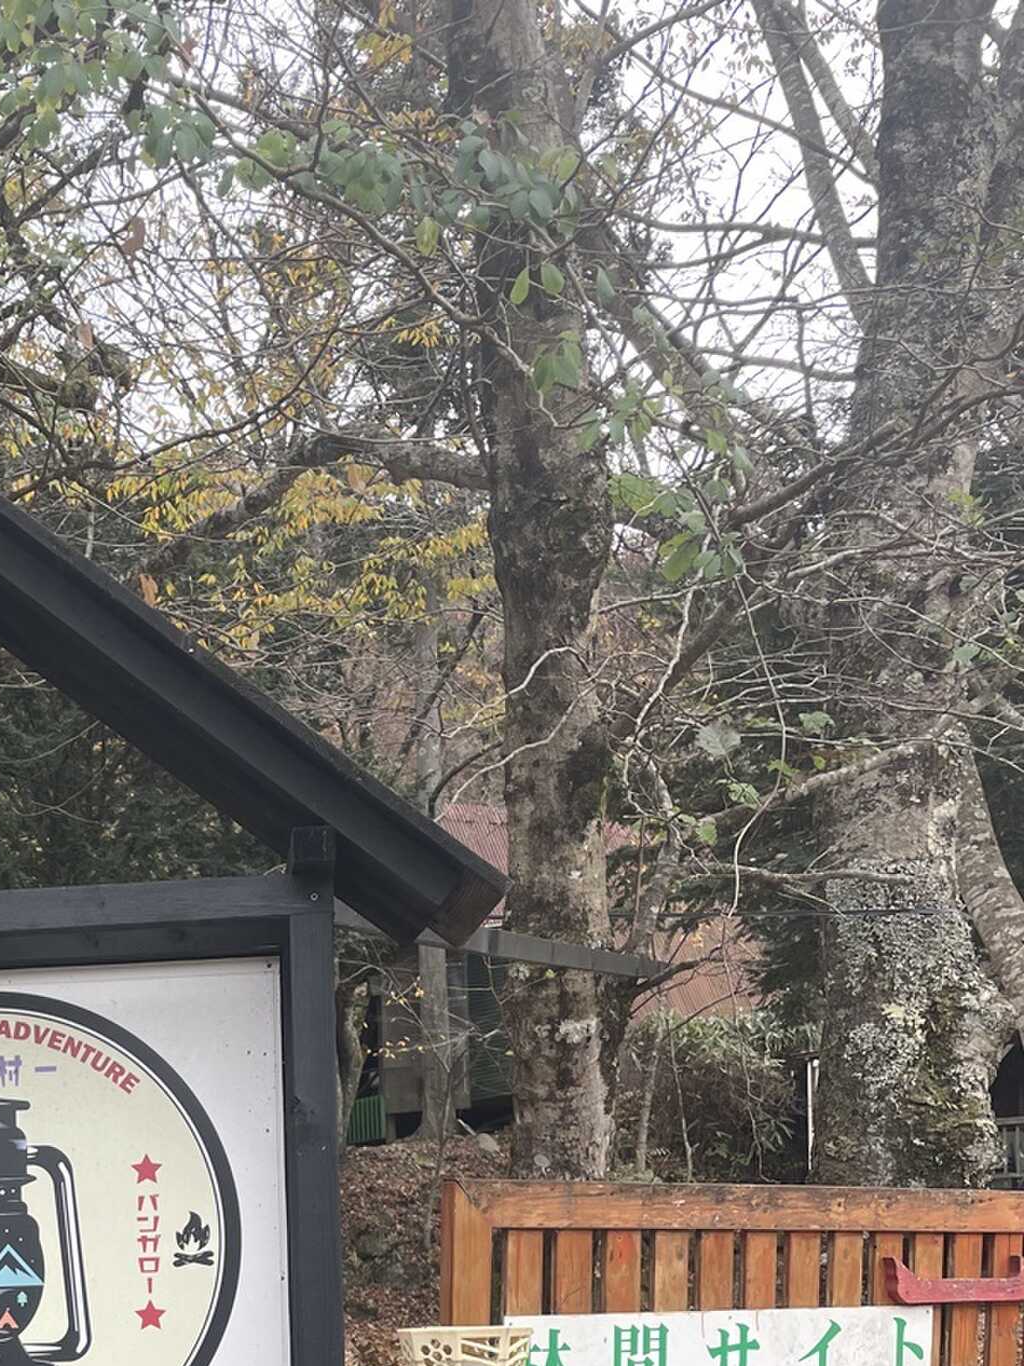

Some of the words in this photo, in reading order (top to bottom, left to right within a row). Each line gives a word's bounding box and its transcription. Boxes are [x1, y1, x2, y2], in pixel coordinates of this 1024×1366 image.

[137, 1194, 161, 1293] バンガロー
